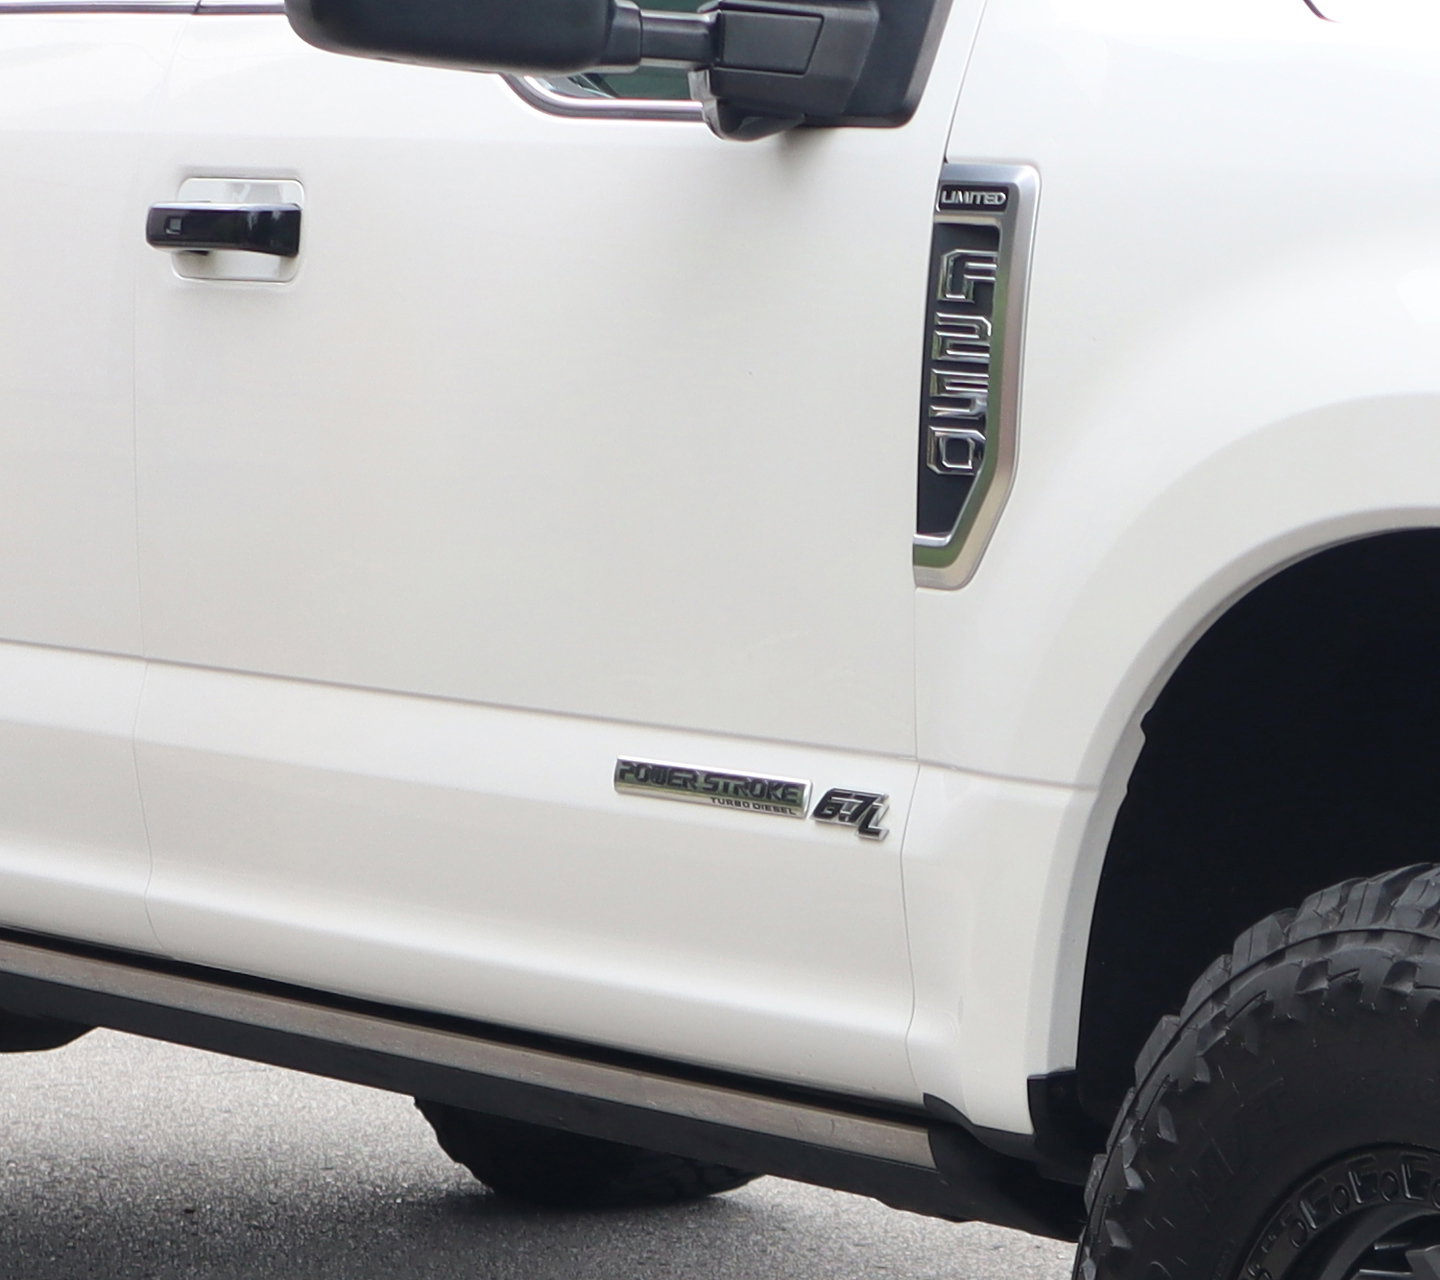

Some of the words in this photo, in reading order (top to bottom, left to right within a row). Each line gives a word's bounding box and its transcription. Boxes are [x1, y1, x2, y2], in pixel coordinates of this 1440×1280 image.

[941, 190, 1007, 205] LIMITED
[617, 760, 699, 791] POWER
[701, 770, 801, 805] STROKE
[710, 796, 751, 809] TURBO
[752, 802, 797, 816] DIESEL
